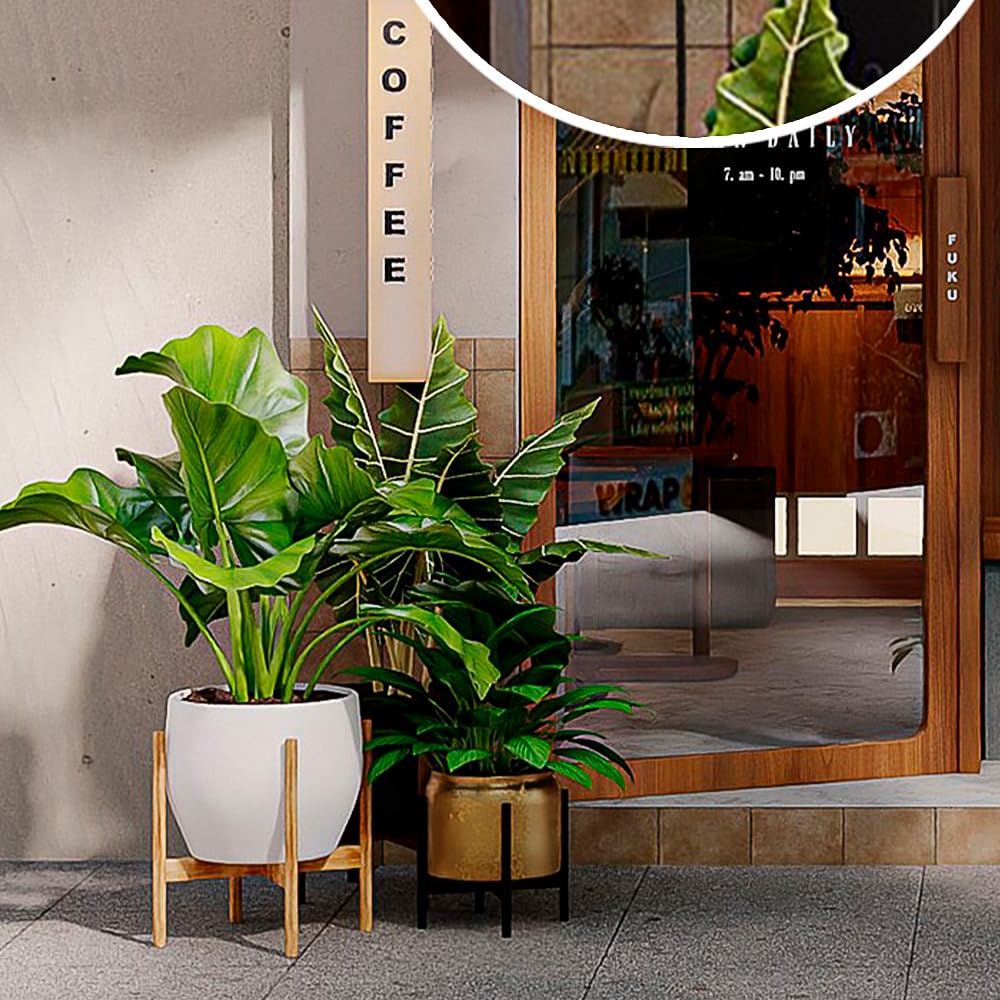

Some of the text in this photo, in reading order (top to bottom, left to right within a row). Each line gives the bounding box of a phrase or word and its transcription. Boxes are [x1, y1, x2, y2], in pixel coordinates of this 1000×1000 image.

[381, 20, 408, 284] COFFEE
[739, 170, 754, 181] am
[789, 169, 805, 184] pm
[947, 233, 958, 301] FUKU
